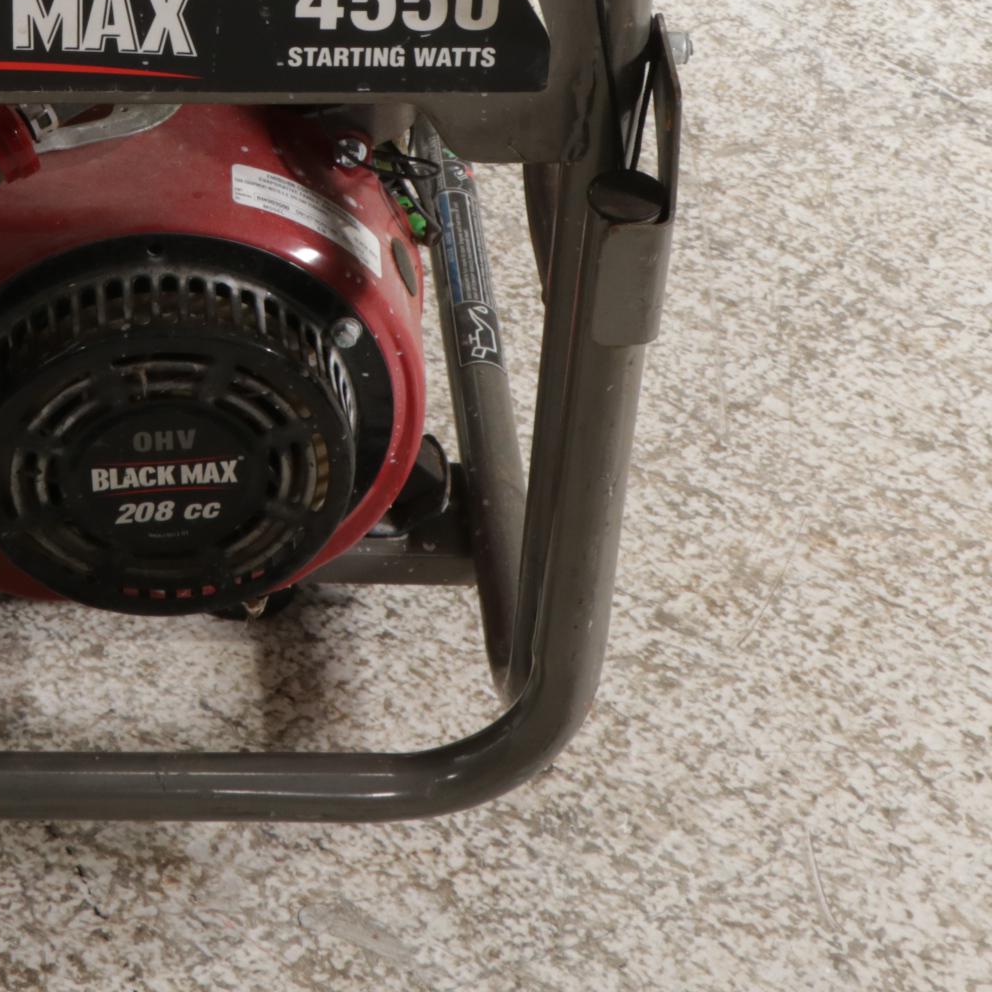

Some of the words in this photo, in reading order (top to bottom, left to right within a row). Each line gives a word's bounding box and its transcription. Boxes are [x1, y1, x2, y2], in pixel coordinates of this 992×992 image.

[287, 44, 406, 68] STARTING
[413, 45, 497, 68] WATTS
[132, 429, 196, 452] OHV
[91, 464, 176, 492] BLACK
[180, 460, 238, 486] MAX
[115, 500, 175, 525] 208
